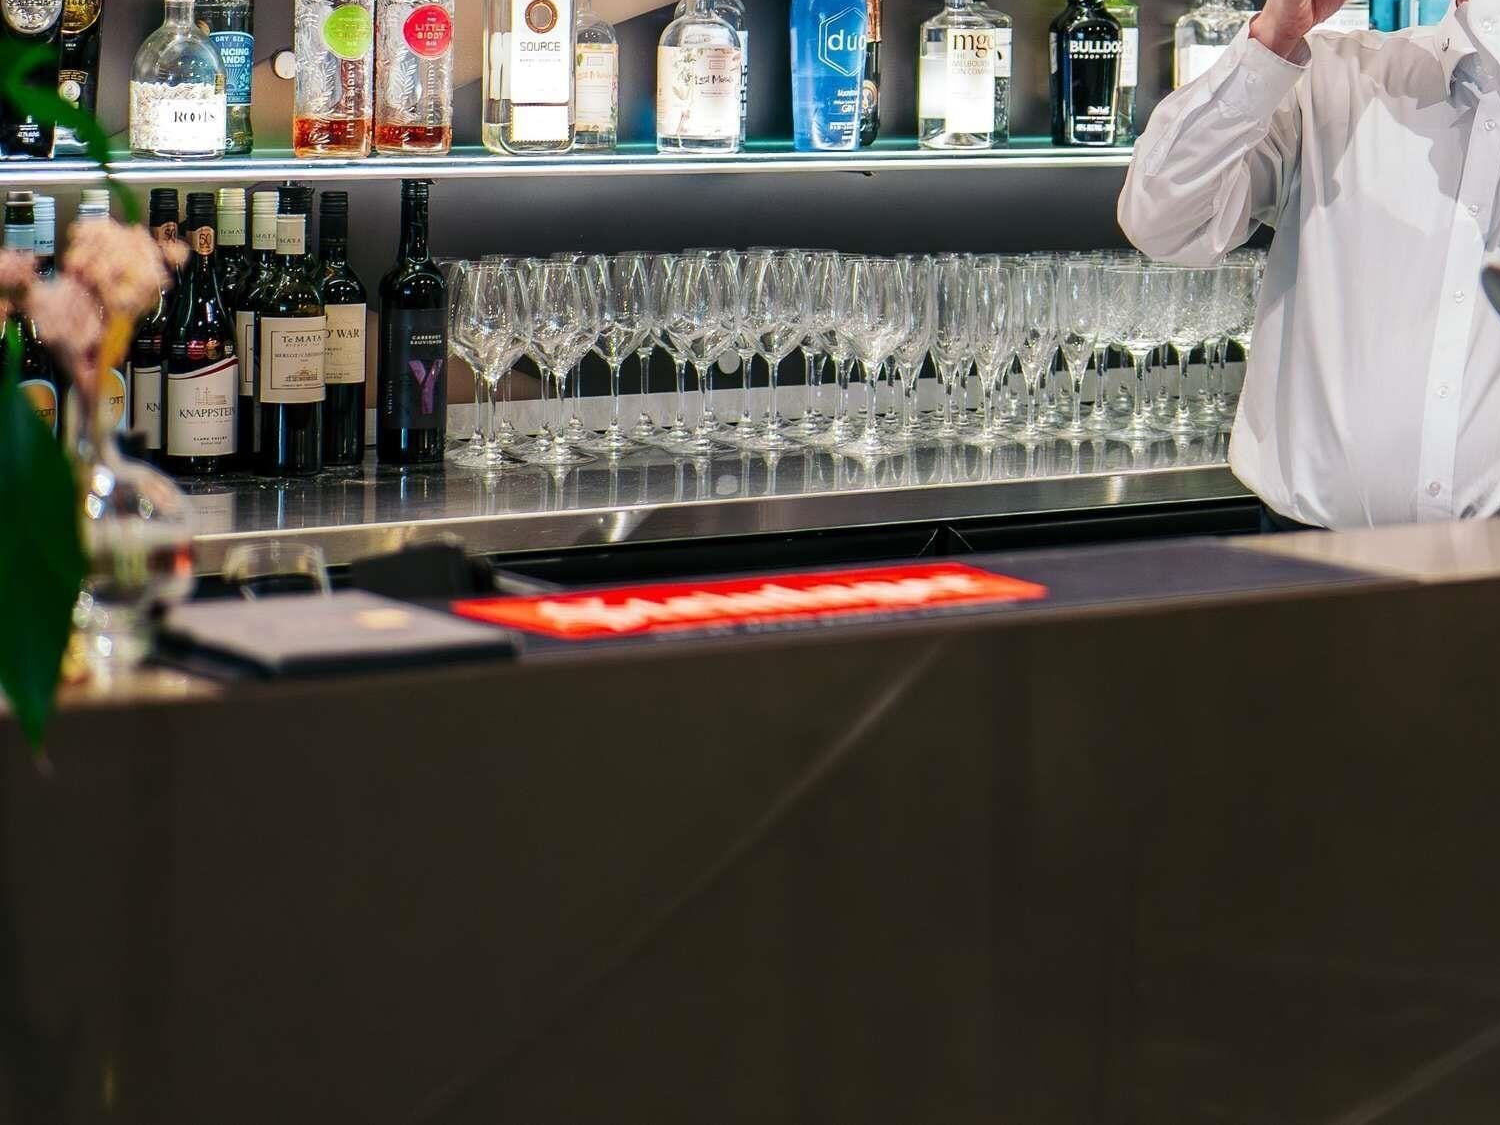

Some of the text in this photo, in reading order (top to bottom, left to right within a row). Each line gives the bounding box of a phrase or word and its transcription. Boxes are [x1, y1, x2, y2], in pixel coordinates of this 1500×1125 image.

[415, 24, 446, 32] LITTLE
[416, 31, 444, 40] BIDDY
[519, 41, 561, 52] SOURCE
[336, 328, 360, 339] WAR
[281, 335, 322, 344] Te MATA
[408, 358, 444, 415] Y
